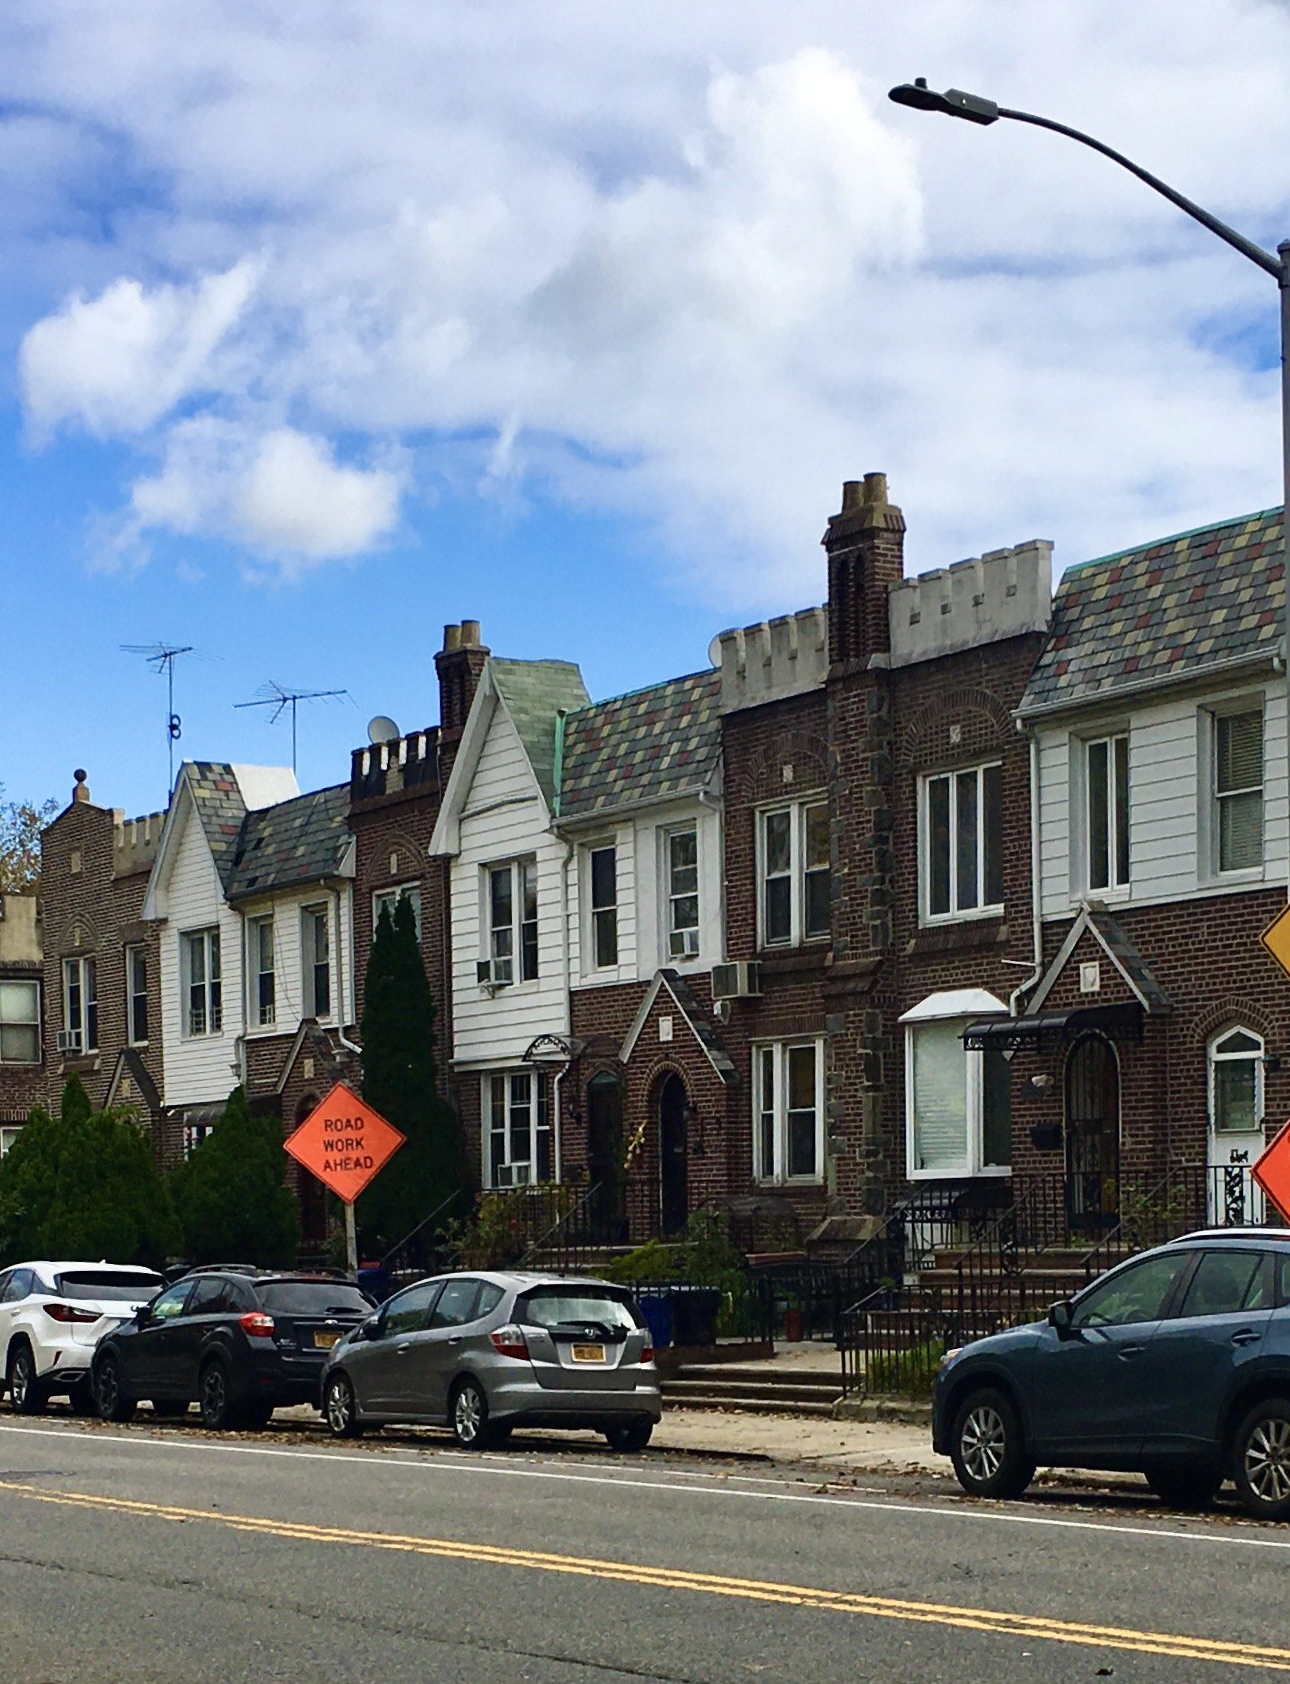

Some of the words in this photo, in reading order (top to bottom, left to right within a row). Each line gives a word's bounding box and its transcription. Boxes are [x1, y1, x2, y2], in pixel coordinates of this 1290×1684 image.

[324, 1116, 364, 1132] ROAD
[323, 1136, 364, 1152] WORK
[323, 1155, 373, 1172] AHEAD
